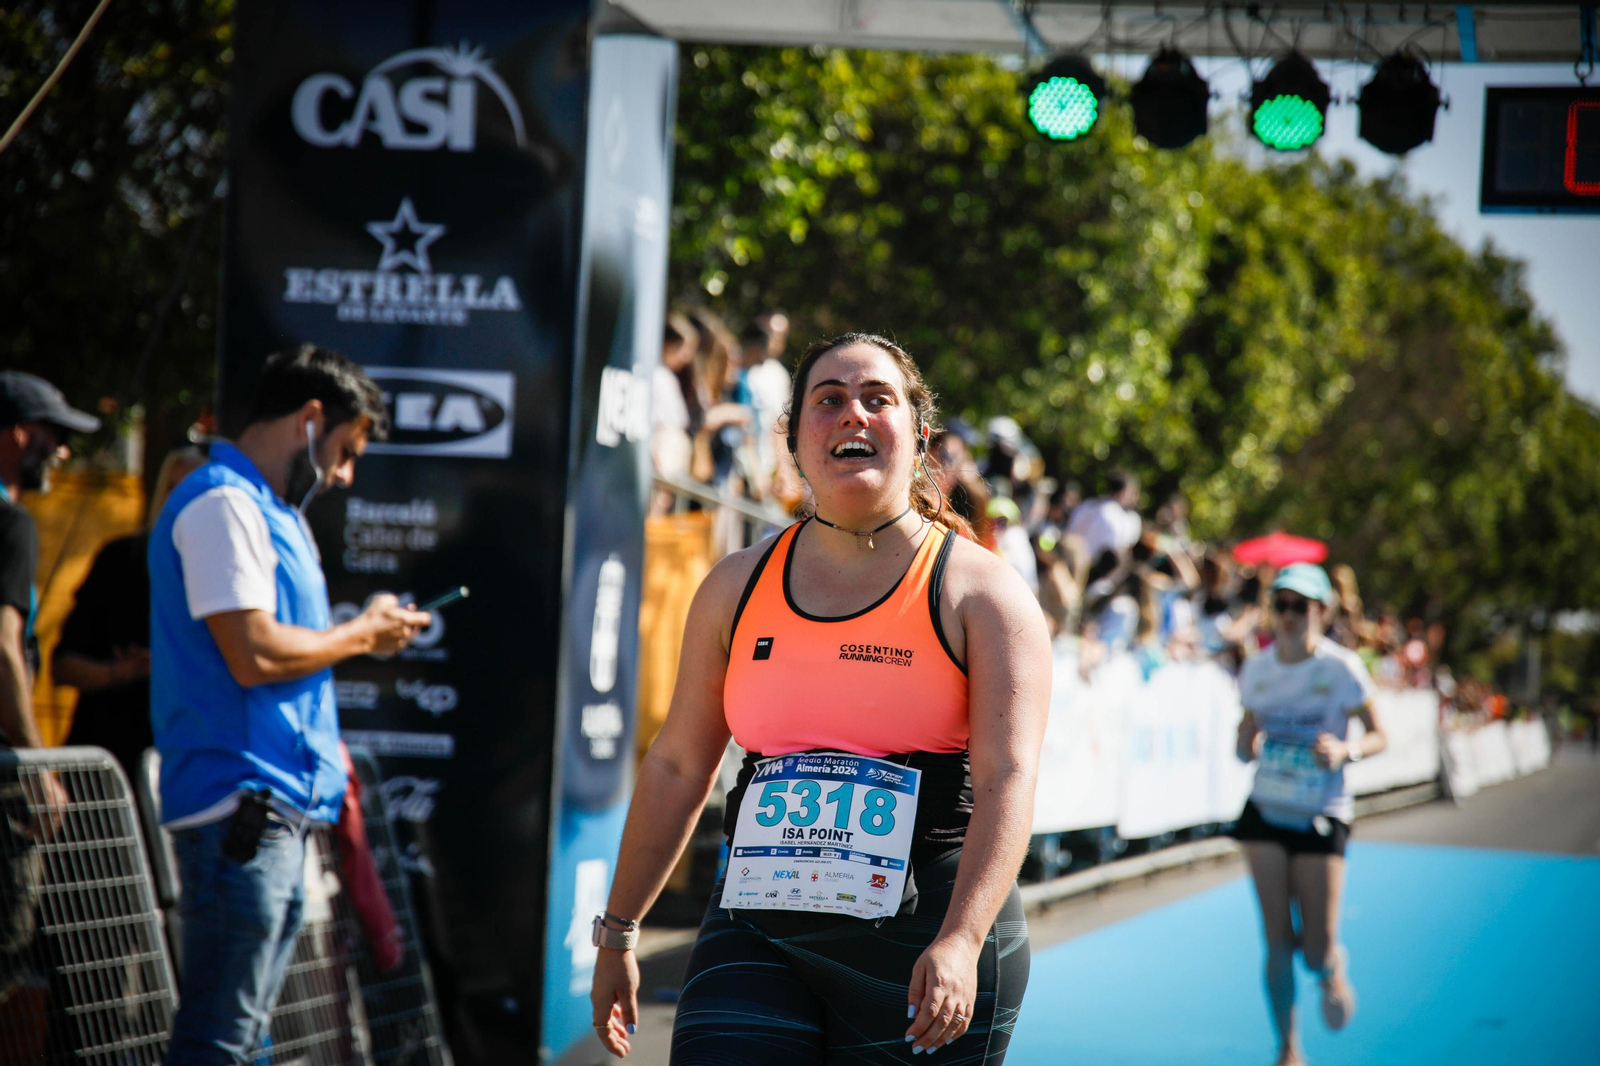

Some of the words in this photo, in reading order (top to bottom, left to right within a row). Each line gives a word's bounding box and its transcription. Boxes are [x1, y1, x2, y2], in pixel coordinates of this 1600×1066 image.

[291, 72, 477, 152] CASI
[285, 267, 521, 311] ESTRELLA
[381, 393, 486, 432] EA
[840, 644, 913, 659] COSENTINO
[839, 653, 883, 663] RUNNING
[884, 656, 912, 667] CREW
[824, 757, 859, 767] Maratón
[795, 763, 831, 774] Almería
[831, 765, 859, 776] 2024
[755, 780, 897, 836] 5318
[782, 827, 803, 840] ISA
[809, 828, 854, 843] POINT
[827, 841, 854, 849] MARTÍNEZ
[772, 870, 800, 881] NEXAL
[824, 871, 855, 880] ALMERÍA
